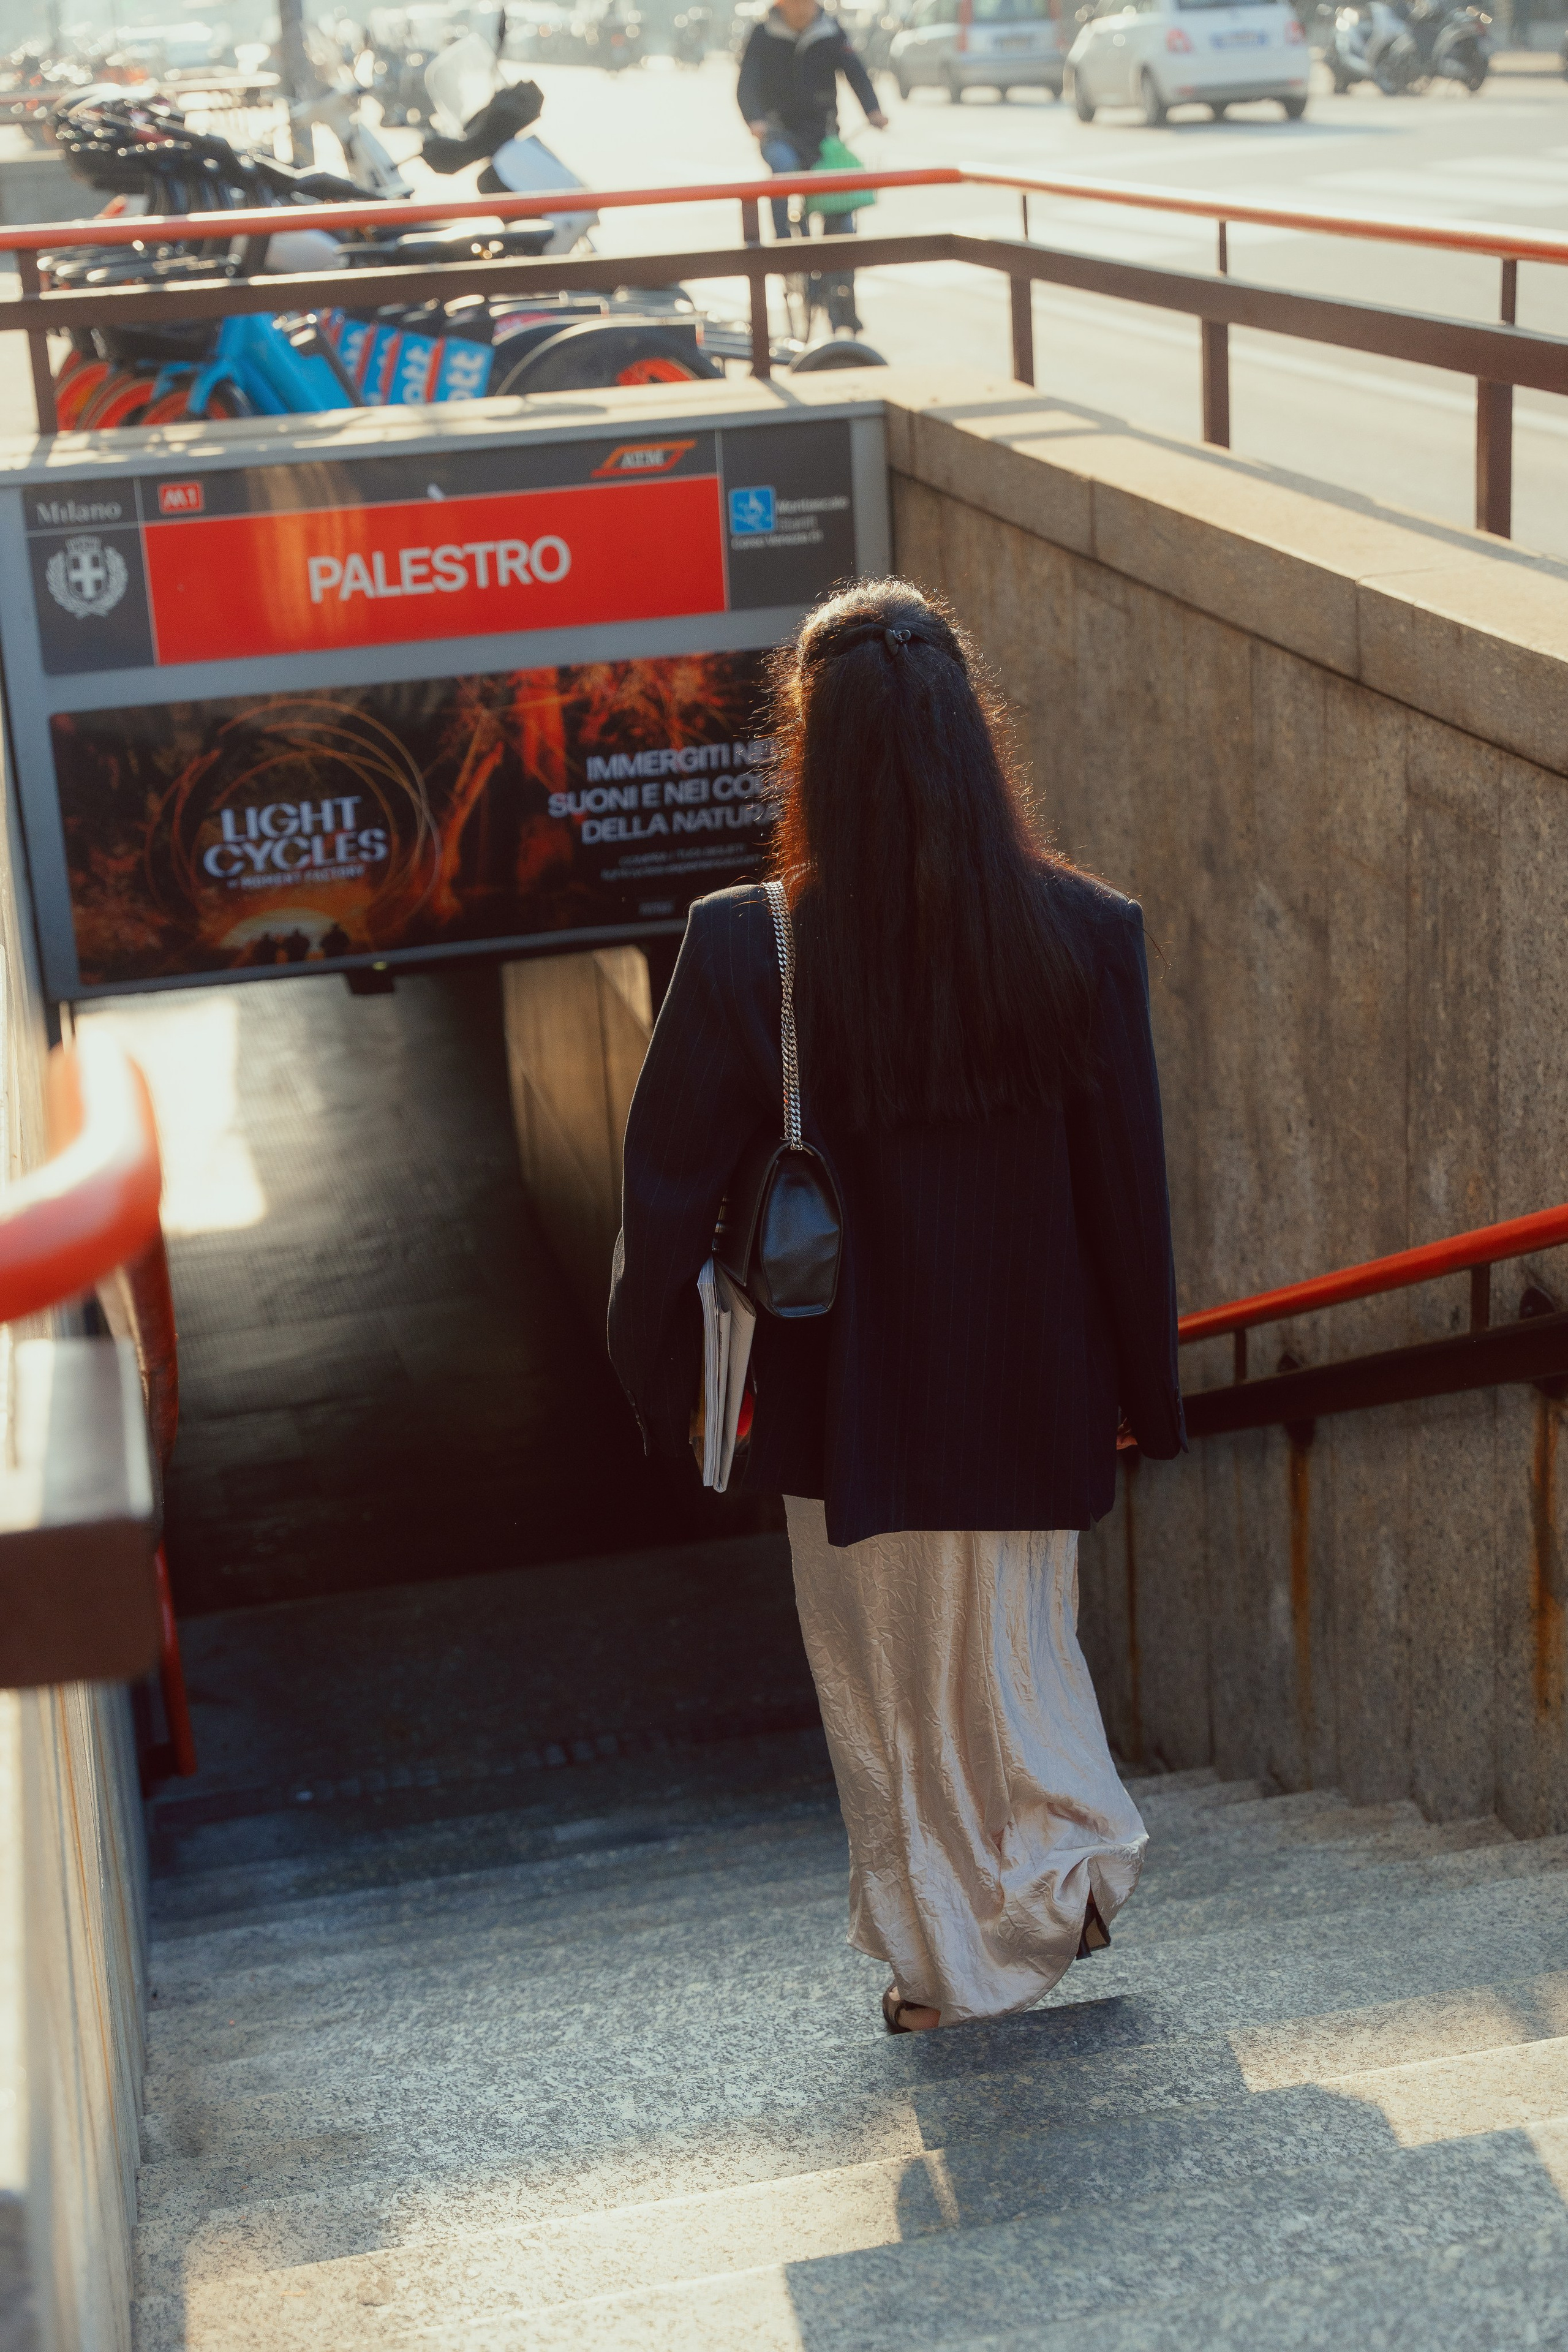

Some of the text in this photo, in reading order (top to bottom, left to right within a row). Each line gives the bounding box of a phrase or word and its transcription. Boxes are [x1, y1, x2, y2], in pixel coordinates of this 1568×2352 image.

[619, 448, 665, 469] ATM
[36, 499, 123, 525] Milano
[307, 535, 571, 604] PALESTRO
[586, 742, 730, 782] IMMERGITI
[548, 785, 639, 818] SUONI
[641, 782, 660, 808] E
[664, 777, 709, 805] NEI
[219, 795, 363, 843] LIGHT
[582, 815, 671, 845] DELLA
[203, 827, 388, 878] CYCLES
